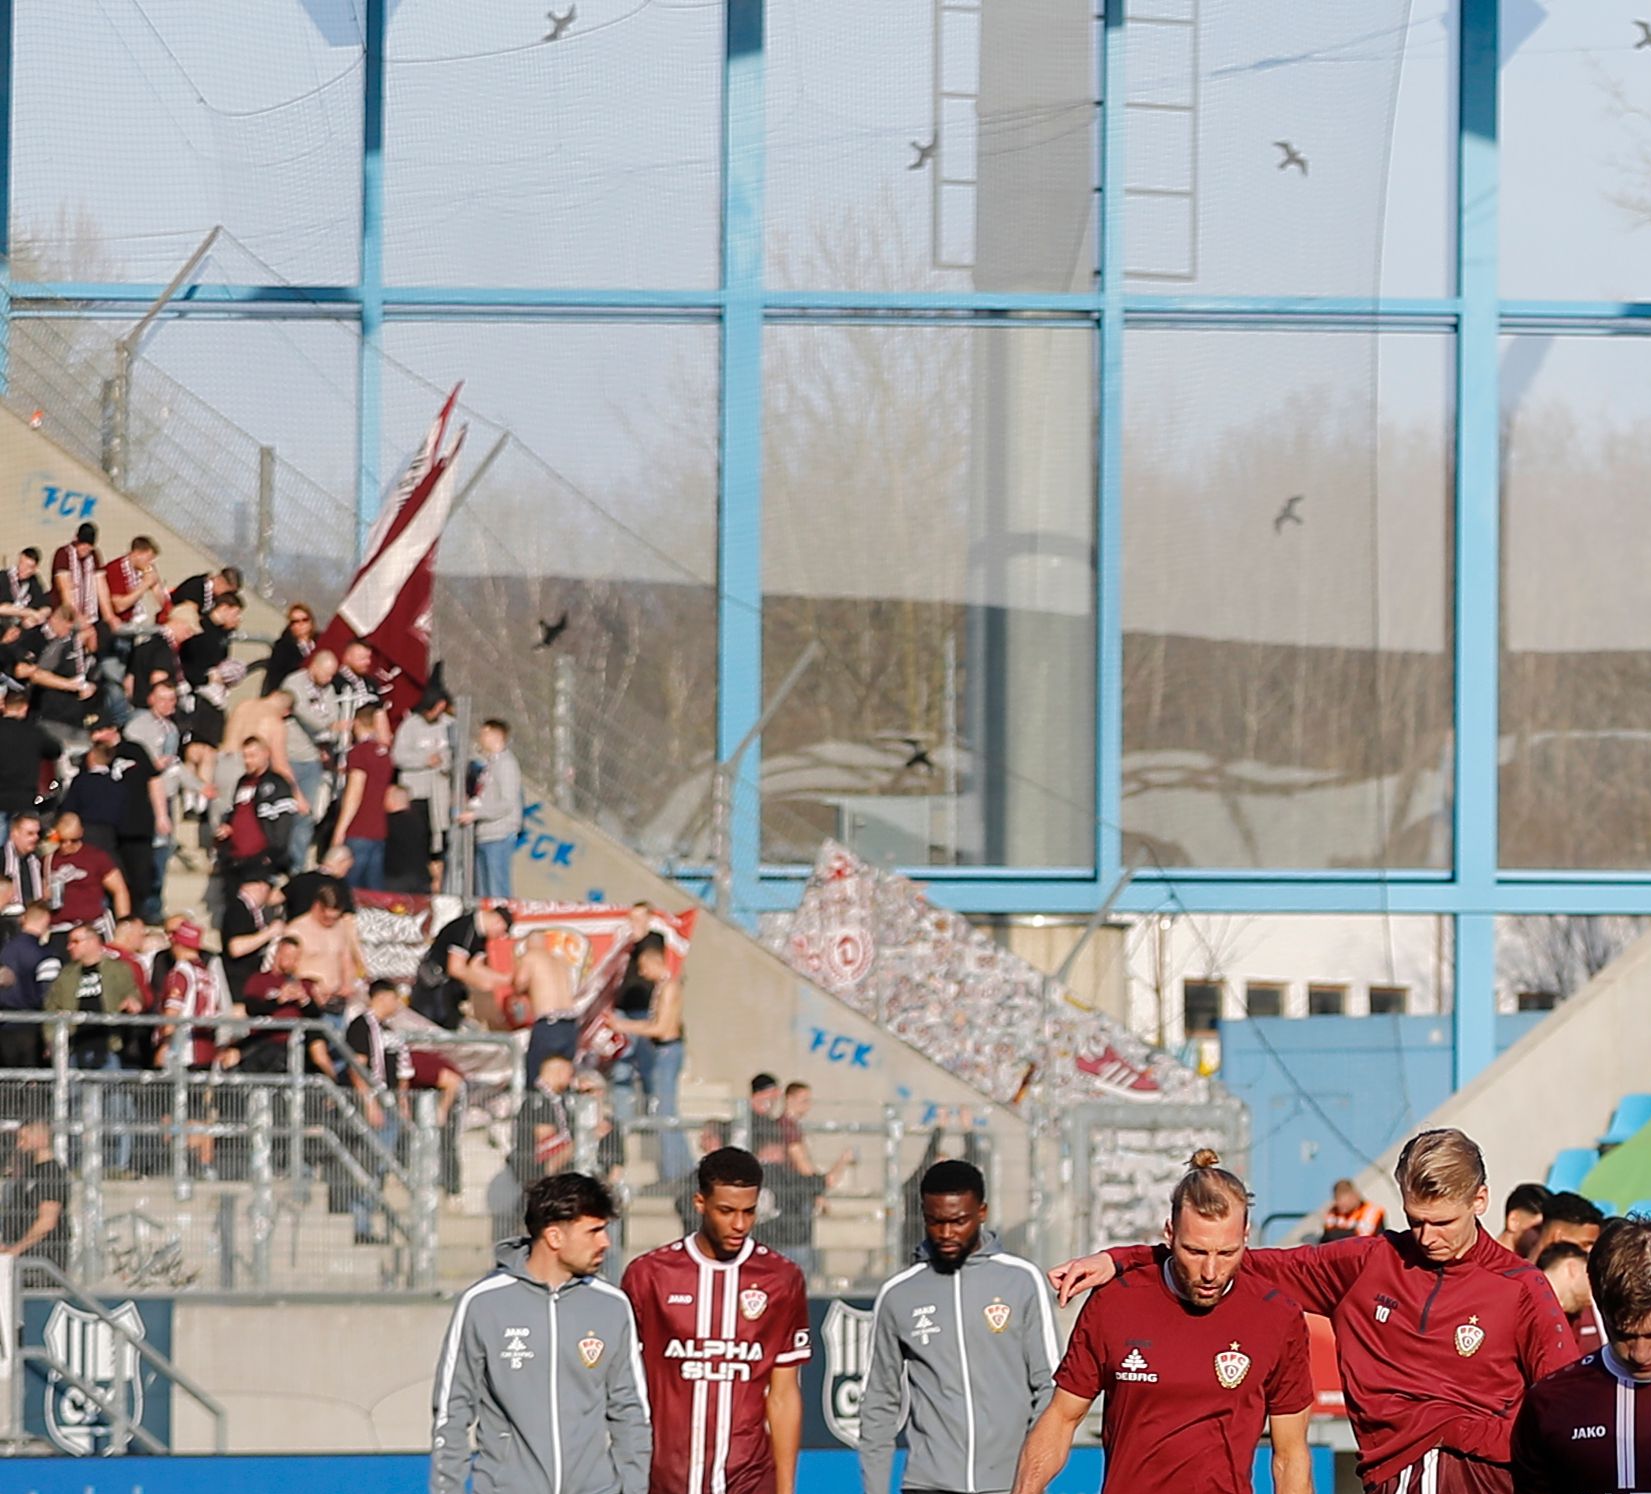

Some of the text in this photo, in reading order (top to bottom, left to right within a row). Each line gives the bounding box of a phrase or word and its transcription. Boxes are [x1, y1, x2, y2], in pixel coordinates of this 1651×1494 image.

[1375, 1305, 1390, 1323] 10
[664, 1339, 763, 1361] ALPHA
[681, 1361, 751, 1382] SUN
[1571, 1425, 1607, 1440] JAKO
